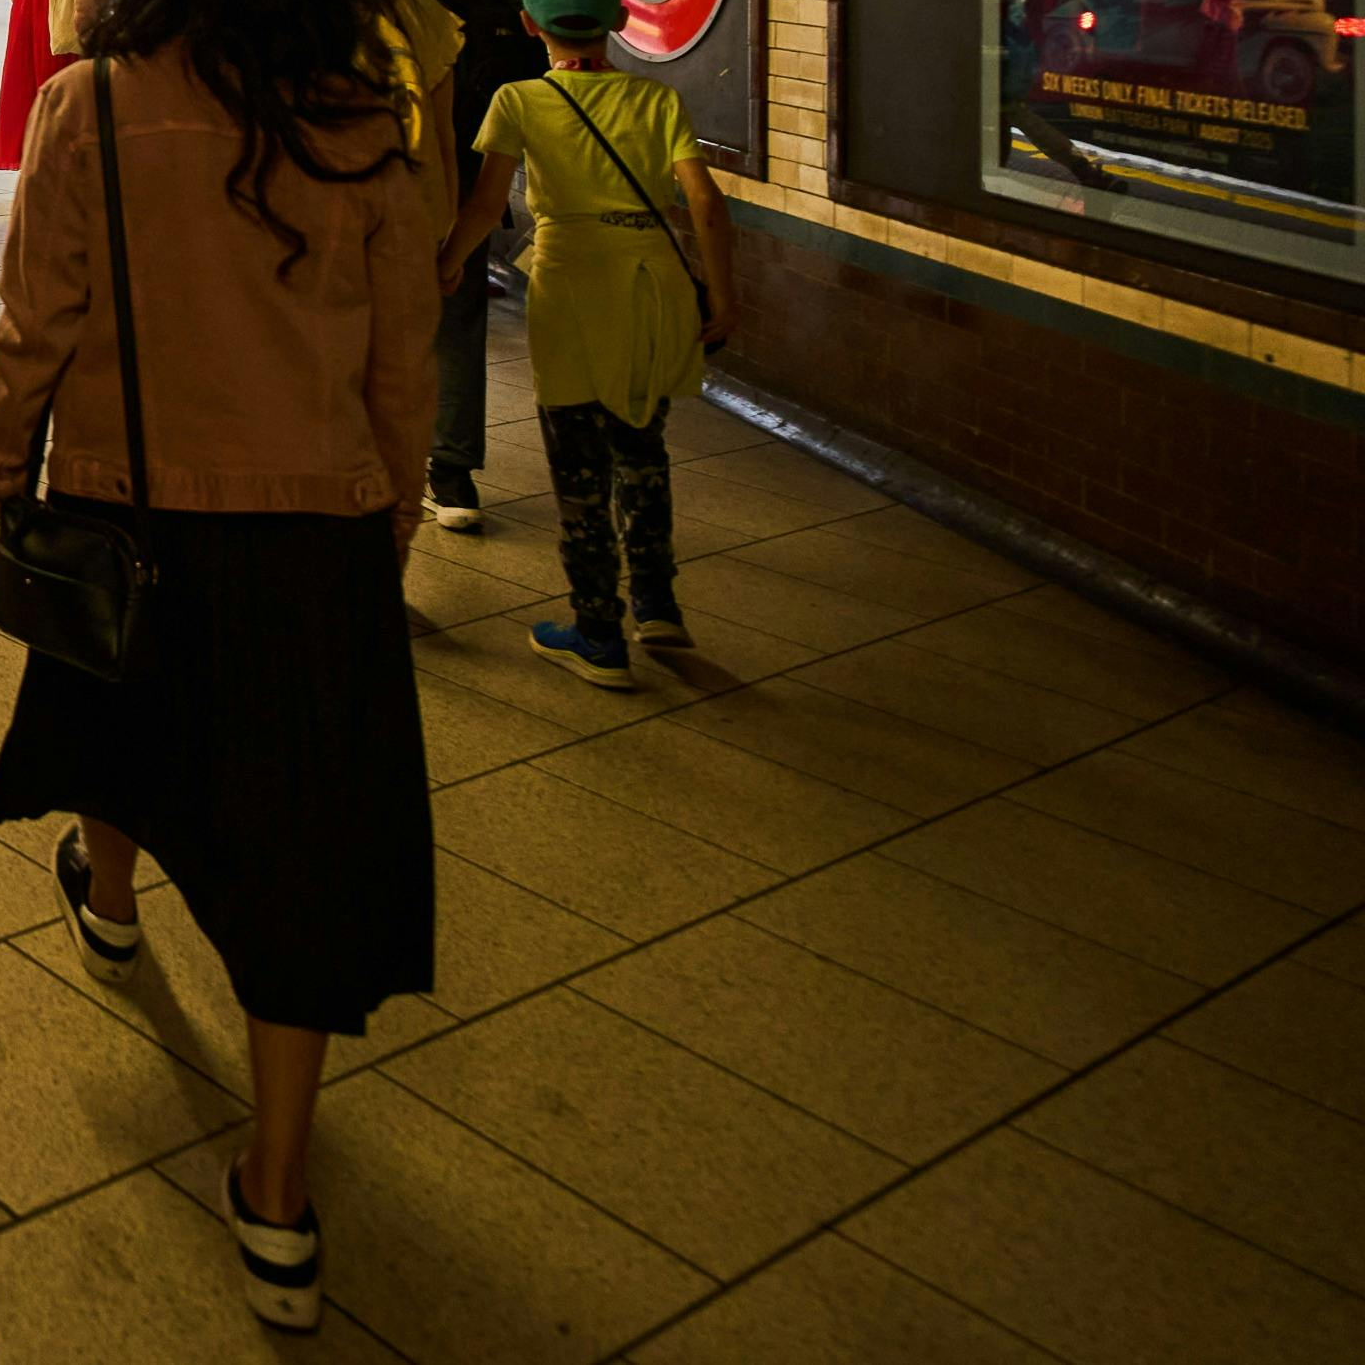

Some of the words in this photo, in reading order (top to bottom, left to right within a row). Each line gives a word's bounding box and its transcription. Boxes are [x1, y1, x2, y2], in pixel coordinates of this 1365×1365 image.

[1042, 71, 1060, 92] SIX
[1061, 75, 1100, 99] WEEKS
[1136, 84, 1173, 110] FINAL
[1174, 90, 1230, 119] TICKETS
